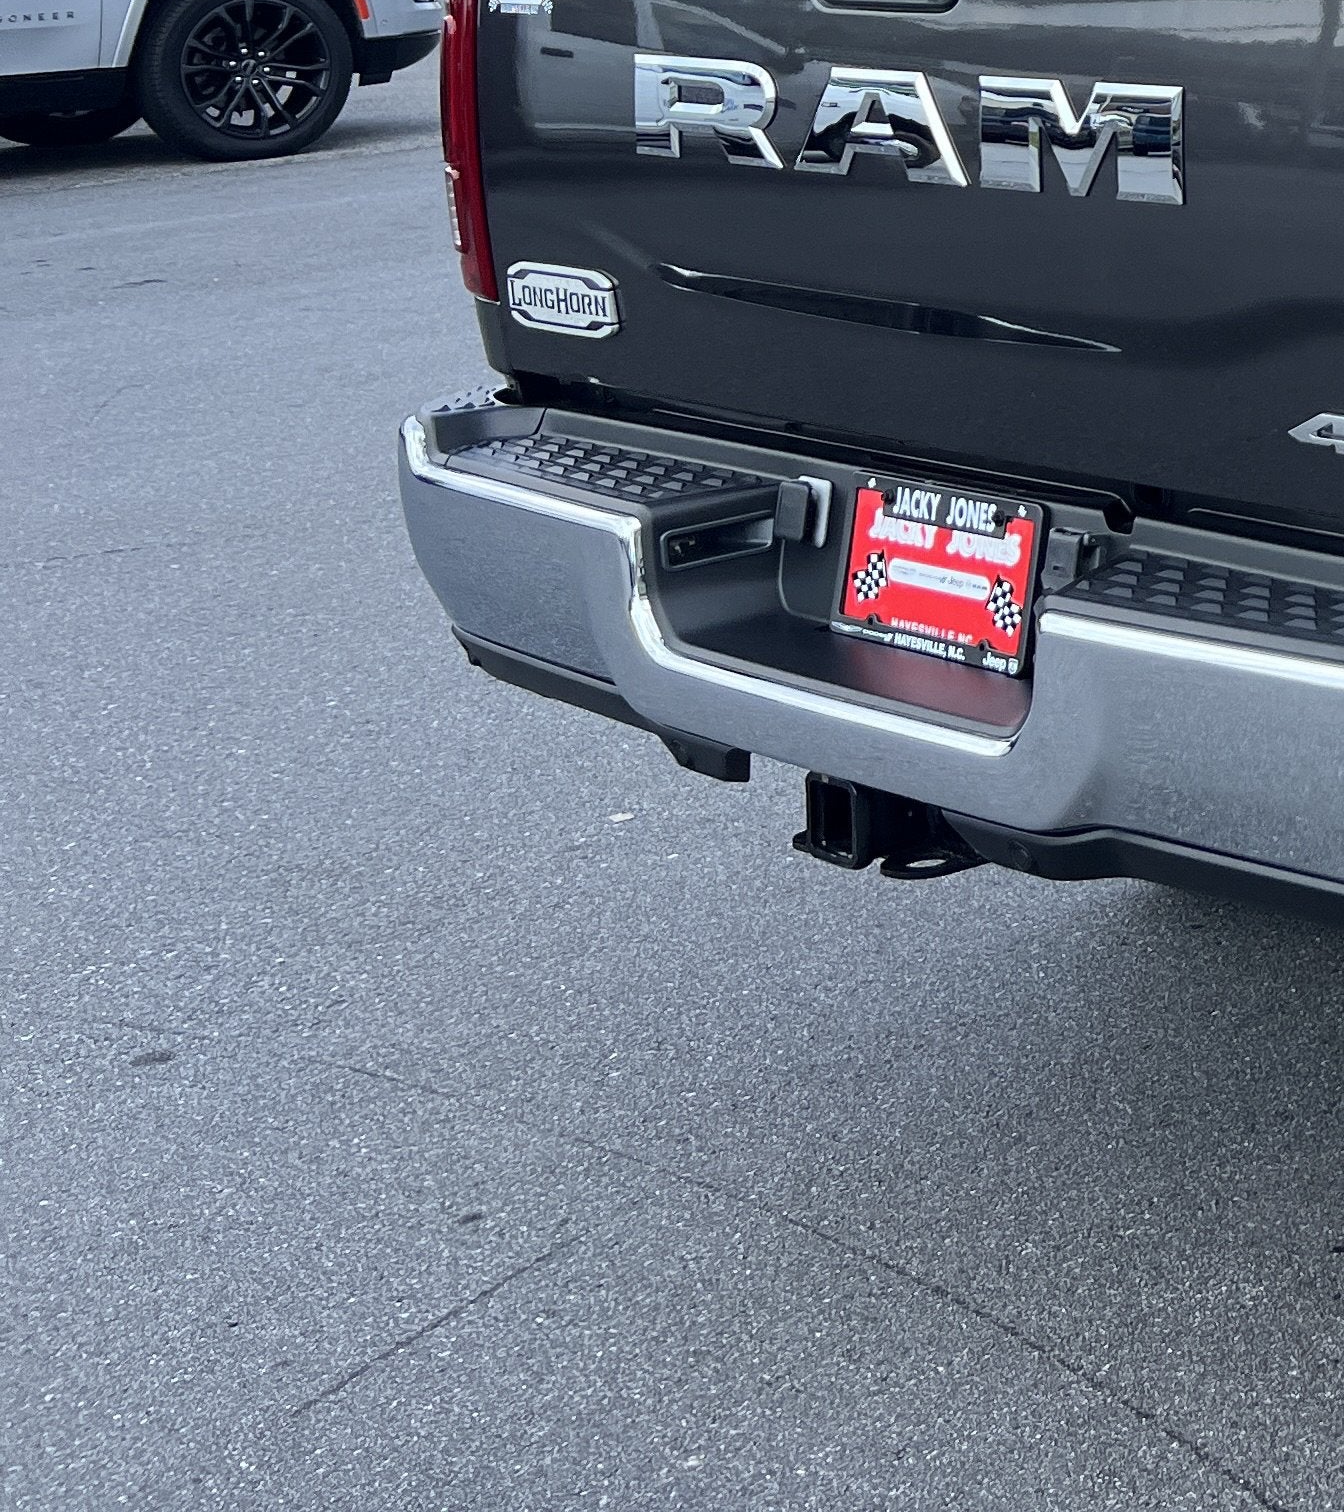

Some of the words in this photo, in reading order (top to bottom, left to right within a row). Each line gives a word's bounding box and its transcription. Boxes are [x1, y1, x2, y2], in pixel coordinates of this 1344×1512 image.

[633, 53, 1184, 206] RAM
[892, 486, 942, 521] JACKY
[946, 497, 998, 533] JONES
[982, 651, 1007, 672] Jeep
